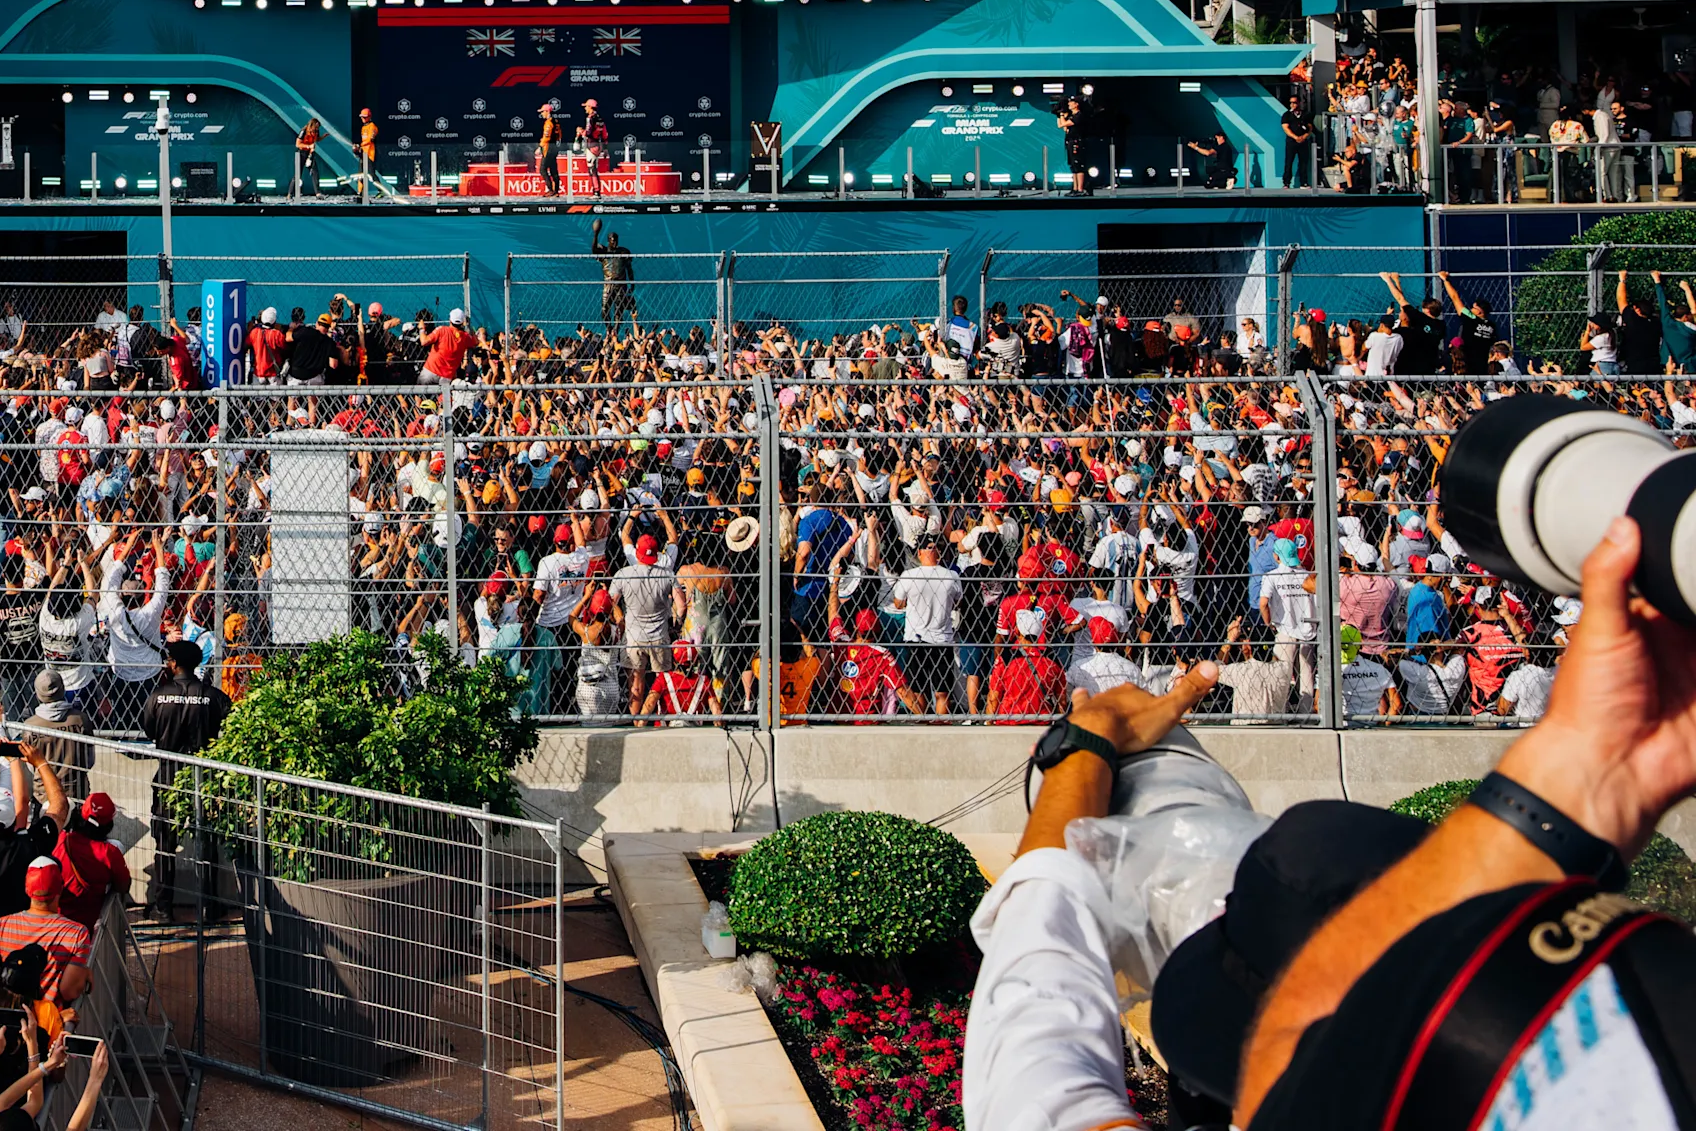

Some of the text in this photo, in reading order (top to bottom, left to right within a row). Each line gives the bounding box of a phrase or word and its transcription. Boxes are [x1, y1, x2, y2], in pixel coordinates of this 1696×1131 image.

[955, 119, 990, 127] MIAMI
[941, 126, 1004, 135] GRAND PRIX
[572, 161, 580, 170] 1
[206, 293, 215, 384] aramco
[228, 288, 243, 386] 100
[157, 695, 210, 706] SUPERVISOR
